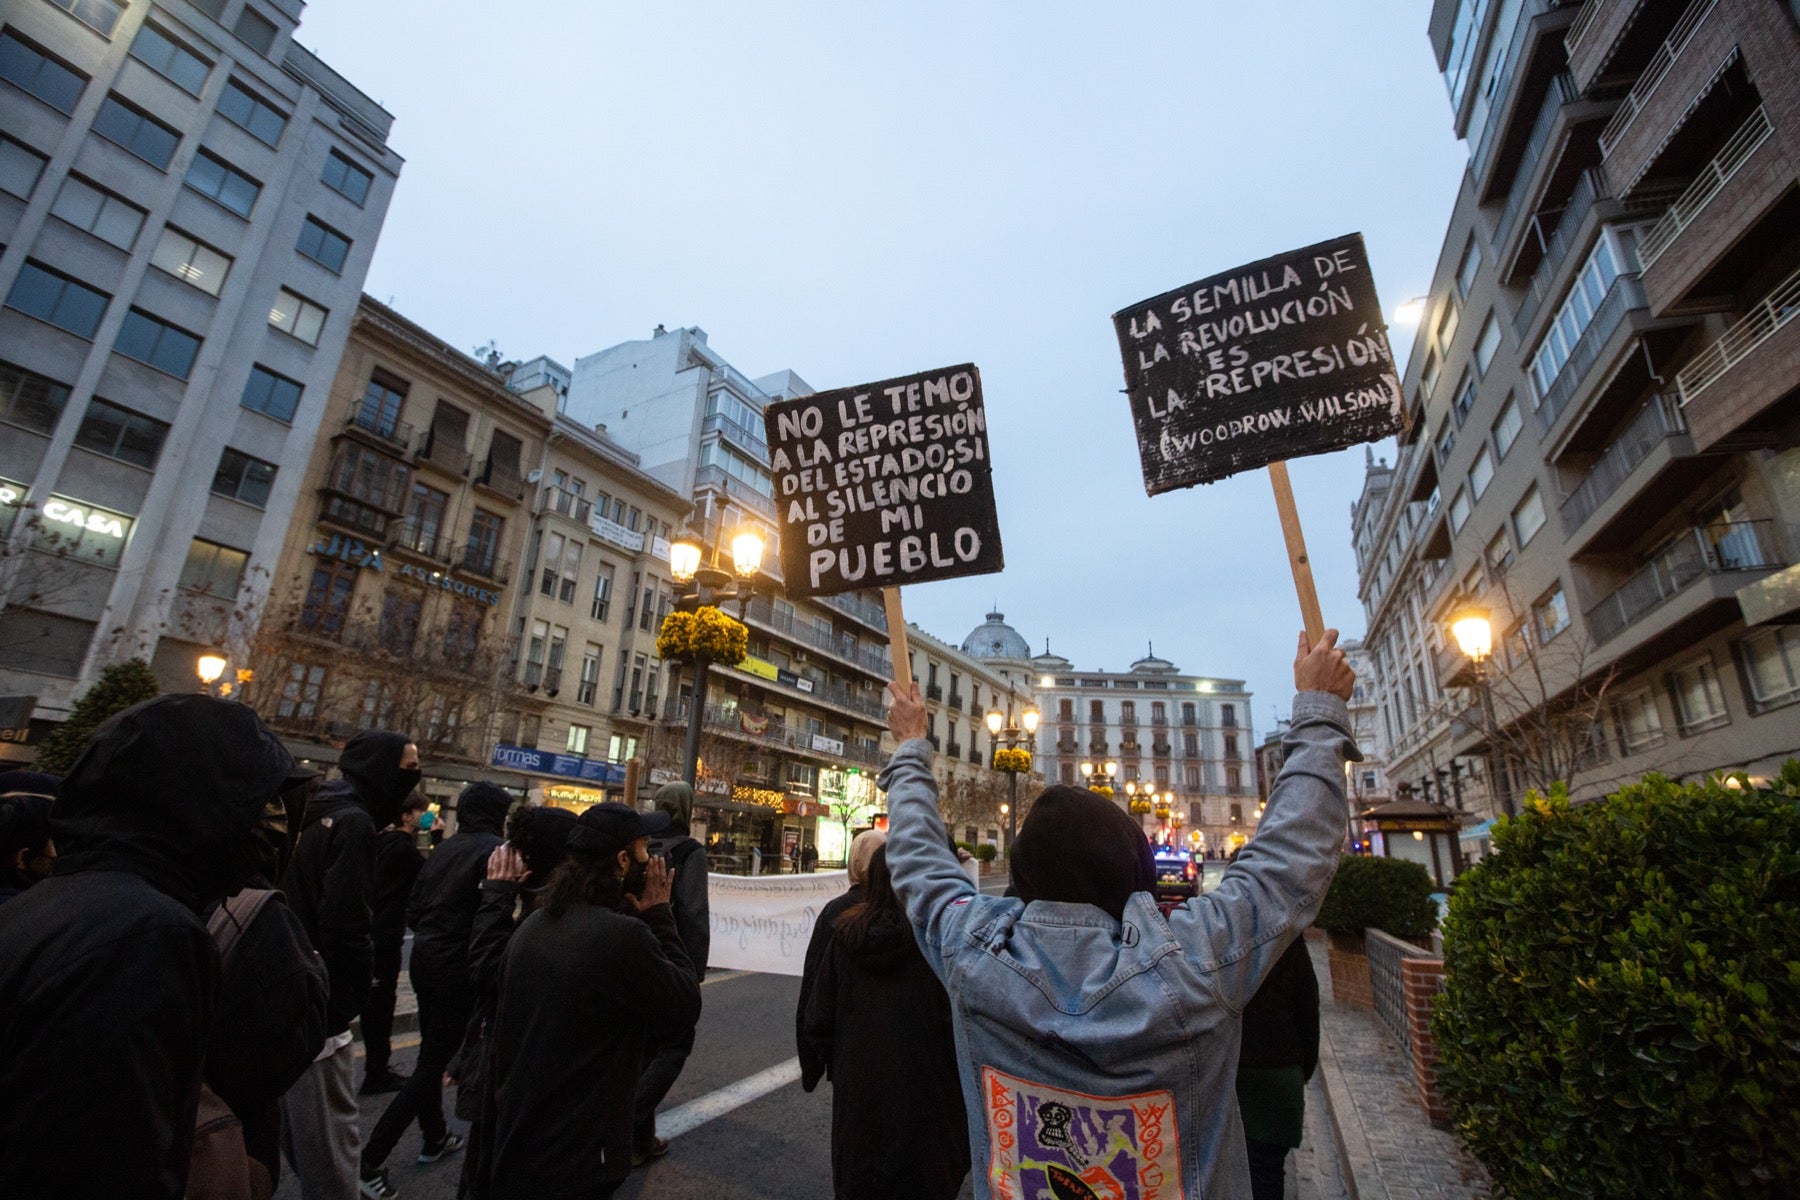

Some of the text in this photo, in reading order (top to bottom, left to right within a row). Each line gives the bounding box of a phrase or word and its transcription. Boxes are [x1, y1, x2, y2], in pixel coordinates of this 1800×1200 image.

[1129, 249, 1357, 339] LA SEMILLA DE
[1138, 281, 1354, 370] LA REVOLUCIÓN
[1148, 322, 1392, 420] LA REPRESIÓN
[1207, 345, 1250, 371] ES
[777, 371, 974, 441] NO LE TEMO
[772, 401, 985, 473] A LA REPRESIÓN
[782, 467, 829, 496] DEL
[787, 469, 973, 524] AL SILENCIO
[43, 502, 123, 538] CASA
[807, 504, 924, 547] DE MI
[401, 563, 500, 606] ASESORES
[810, 526, 982, 588] PUEBLO
